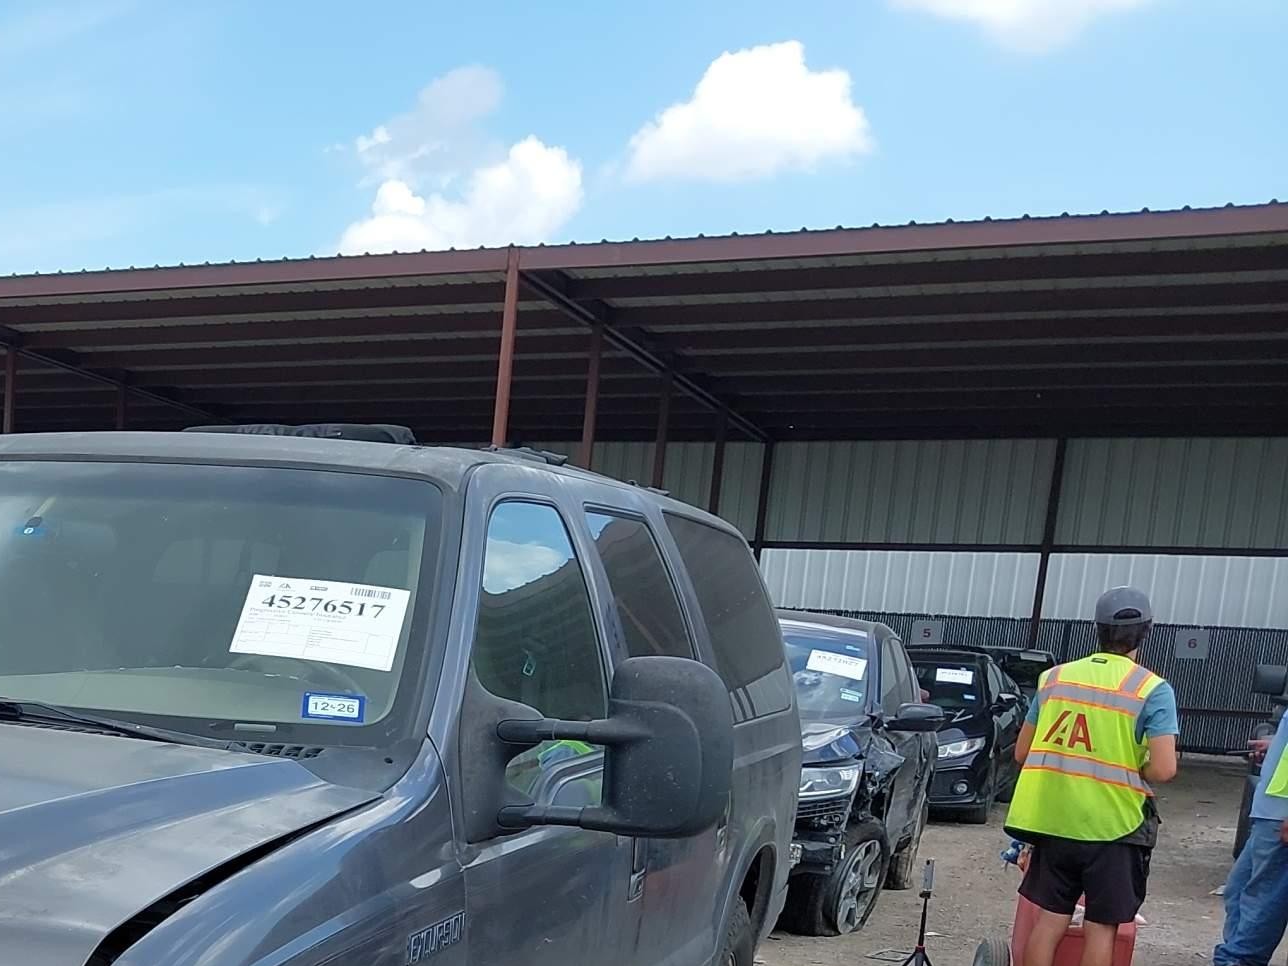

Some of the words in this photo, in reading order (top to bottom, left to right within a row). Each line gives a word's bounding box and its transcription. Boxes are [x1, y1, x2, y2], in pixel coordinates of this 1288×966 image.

[262, 593, 387, 620] 45276517
[922, 628, 932, 638] 5
[1187, 638, 1197, 648] 6
